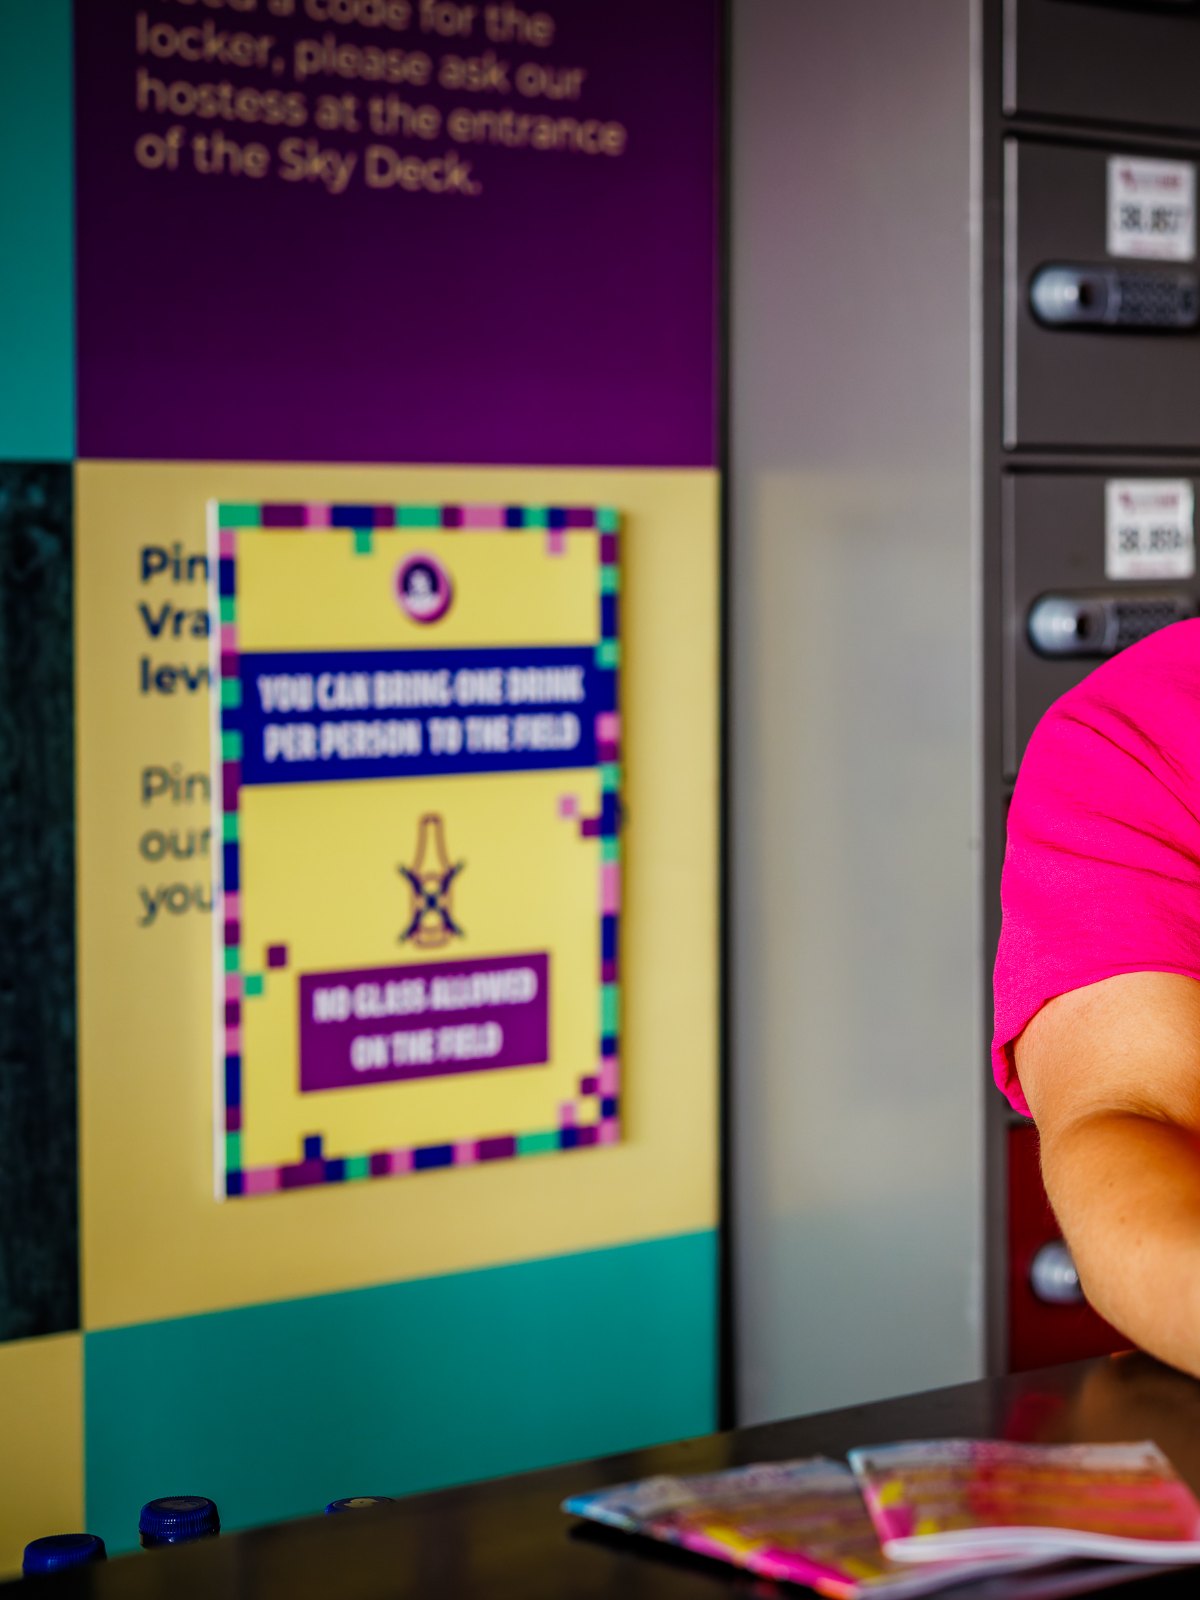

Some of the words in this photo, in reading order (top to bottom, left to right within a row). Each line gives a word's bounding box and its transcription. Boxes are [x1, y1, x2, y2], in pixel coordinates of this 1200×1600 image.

[419, 0, 477, 37] for
[484, 2, 556, 47] the
[136, 10, 285, 77] locker,
[294, 32, 432, 86] please
[438, 51, 511, 94] ask
[516, 62, 584, 100] our
[135, 67, 307, 127] hostess
[315, 93, 361, 132] at
[369, 93, 441, 140] the
[447, 106, 627, 156] entrance
[135, 125, 184, 170] of
[193, 129, 270, 179] the
[278, 136, 357, 195] Sky
[364, 143, 482, 196] Deck.
[257, 672, 313, 714] YOU
[316, 671, 370, 712] CAN
[373, 668, 452, 708] BRING
[454, 667, 503, 706] ONE
[507, 665, 584, 705] DRINK
[263, 721, 317, 763] PER
[320, 719, 422, 761] PERSON
[427, 716, 462, 755] TO
[465, 714, 509, 753] THE
[512, 712, 580, 752] FIELD
[312, 984, 350, 1024] NO
[353, 977, 426, 1020] GLASS
[430, 967, 537, 1011] ALLOWED
[350, 1034, 389, 1072] ON
[391, 1028, 434, 1067] THE
[436, 1021, 504, 1061] FIELD
